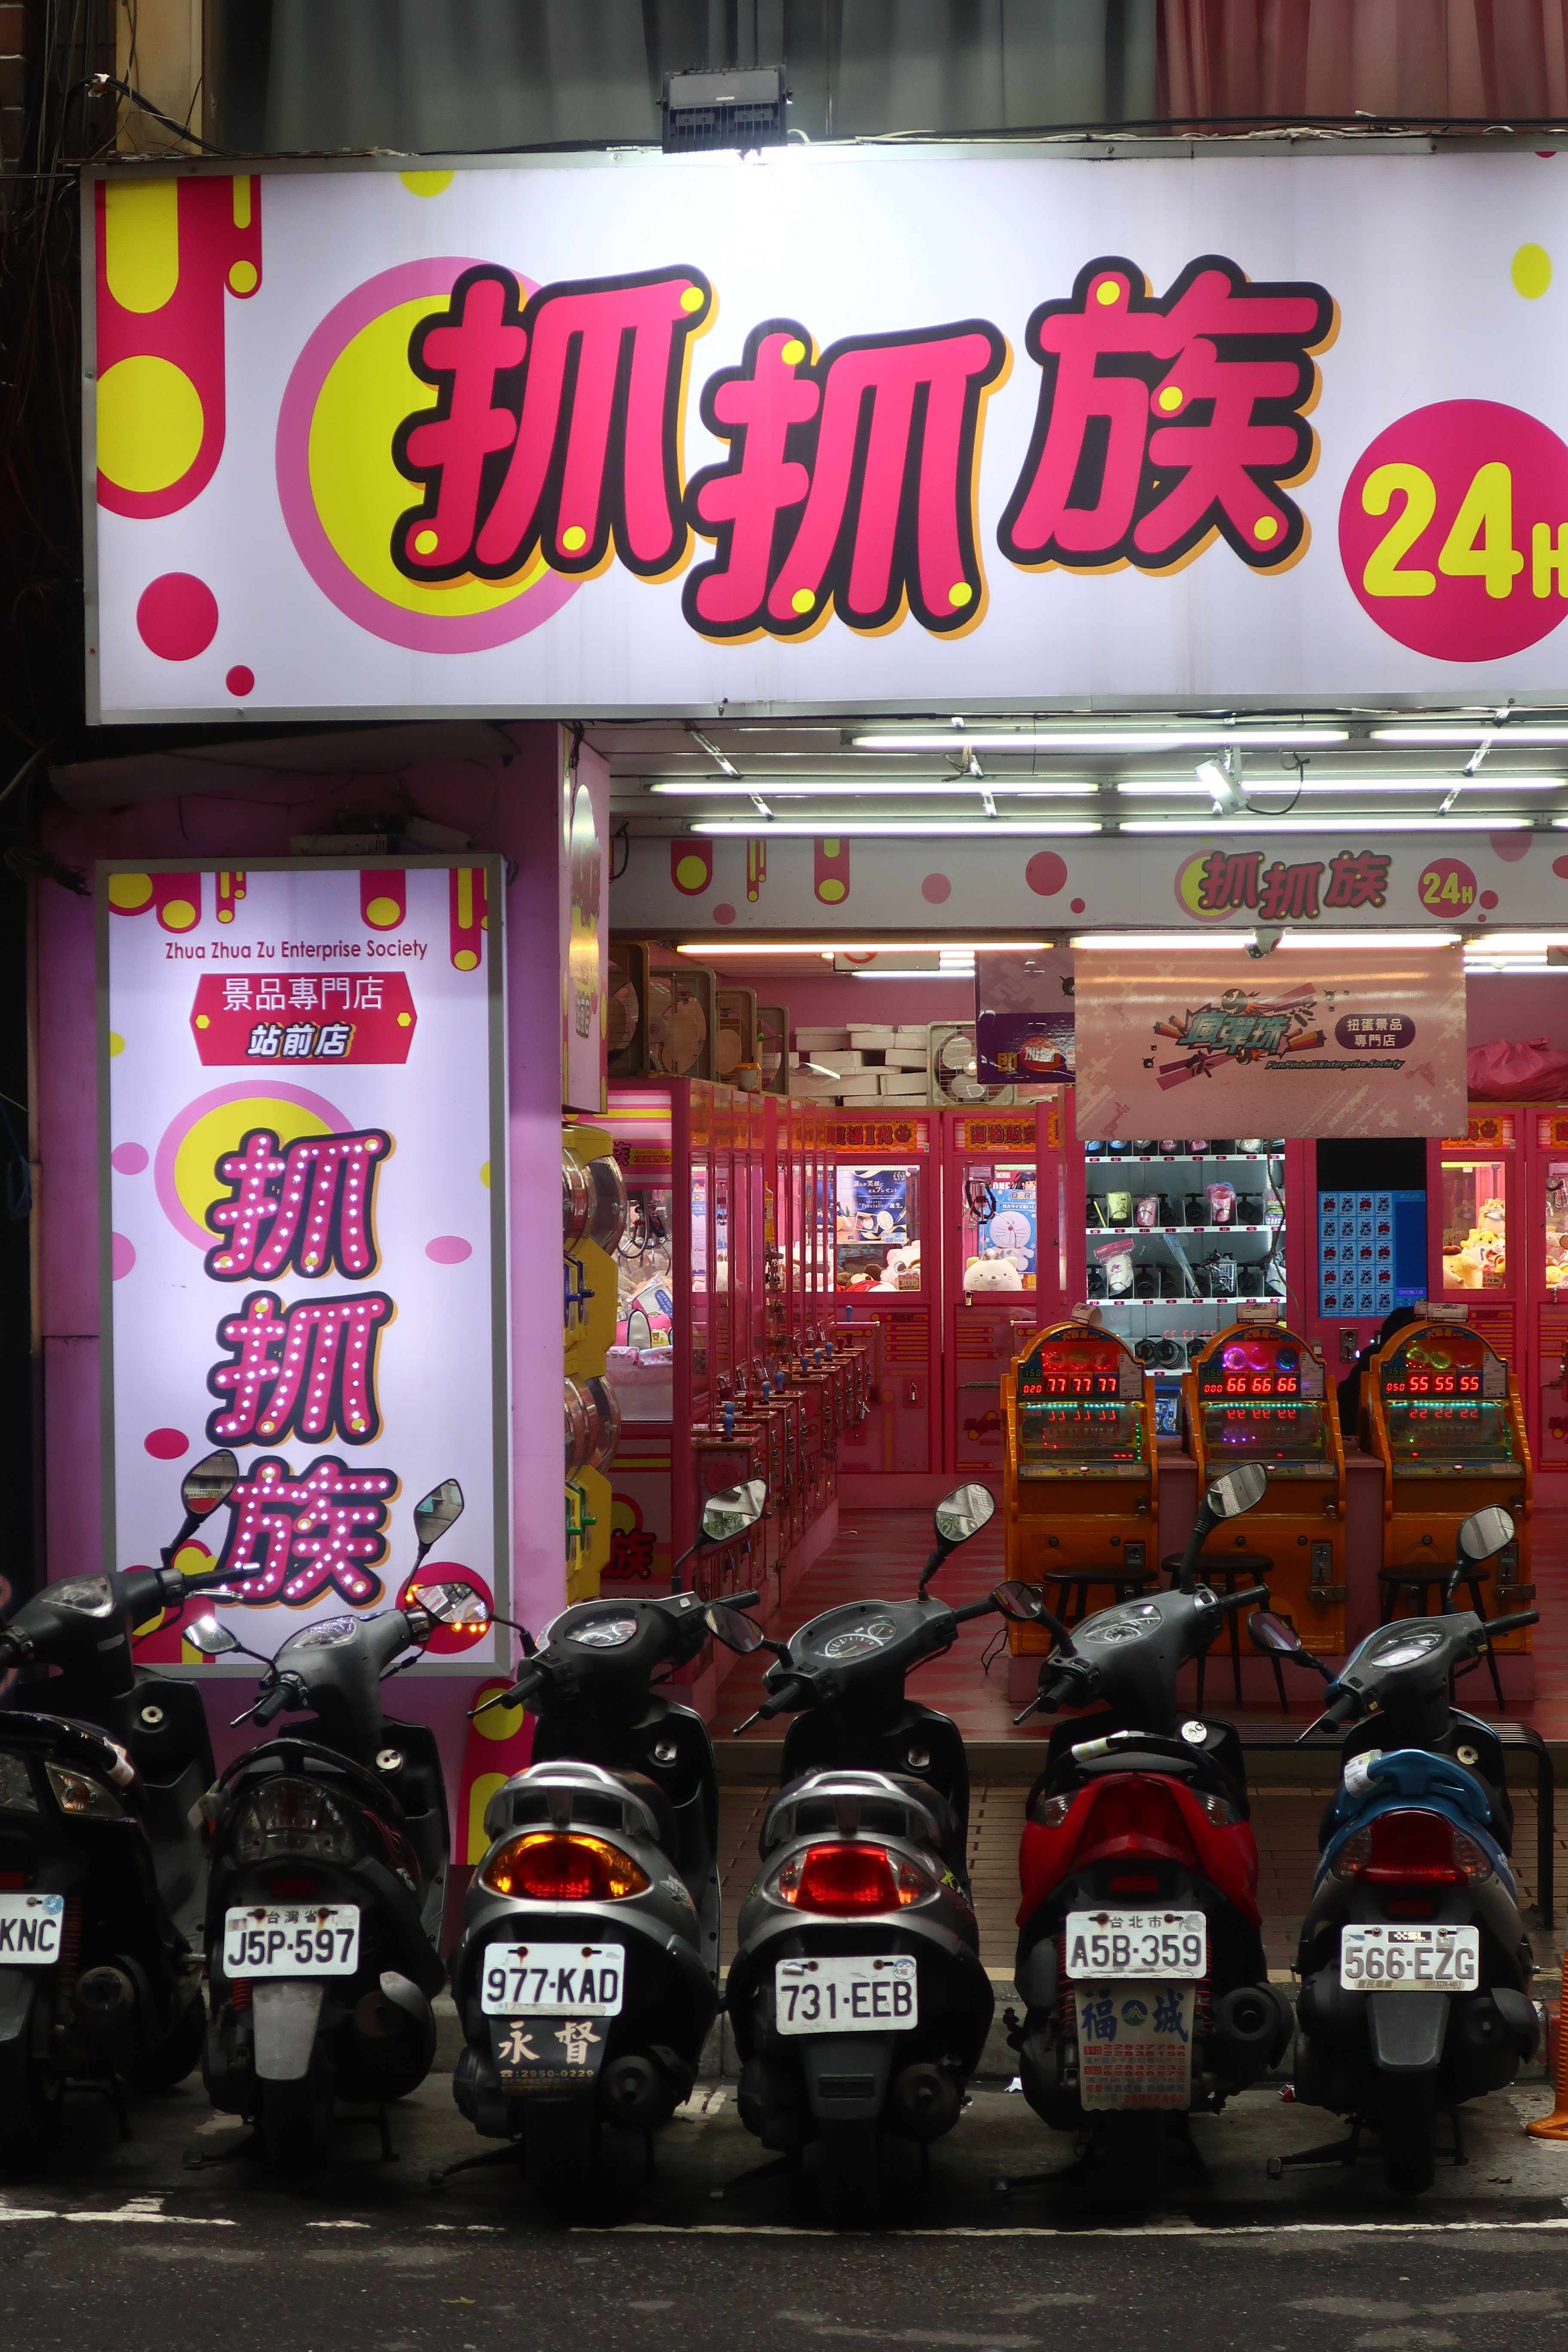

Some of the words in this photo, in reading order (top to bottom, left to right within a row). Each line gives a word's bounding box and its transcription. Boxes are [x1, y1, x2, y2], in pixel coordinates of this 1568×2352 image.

[392, 254, 1336, 637] 抓抓族
[1198, 850, 1391, 919] 抓抓族
[1423, 872, 1473, 904] 24H
[165, 942, 205, 959] Zhua
[211, 941, 251, 959] Zhua
[257, 941, 275, 958] Zu
[282, 940, 361, 962] Enterprise
[367, 939, 428, 960] Society
[222, 976, 384, 1011] 景品專門店
[1347, 1018, 1402, 1031] 扭蛋景品
[247, 1022, 352, 1058] 站前店
[1355, 1034, 1396, 1047] 專門店
[1265, 1060, 1318, 1069] FunPinball
[1318, 1060, 1367, 1070] Enterprise
[1369, 1059, 1406, 1070] Society
[205, 1128, 395, 1607] 抓抓族
[1048, 1378, 1066, 1391] 77
[1073, 1378, 1091, 1391] 77
[1098, 1378, 1116, 1391] 77
[1228, 1378, 1246, 1391] 66
[1253, 1378, 1271, 1391] 66
[1277, 1378, 1297, 1391] 66
[1386, 1383, 1405, 1391] 050
[1410, 1377, 1429, 1390] 55
[1435, 1377, 1454, 1390] 55
[1460, 1377, 1479, 1390] 55
[600, 1527, 657, 1580] 族
[266, 1911, 319, 1925] 台灣省
[1109, 1916, 1162, 1929] 台北市
[0, 1918, 56, 1952] KNC
[1081, 1987, 1118, 2042] 福
[1152, 1988, 1189, 2043] 城
[498, 2021, 601, 2065] 永督
